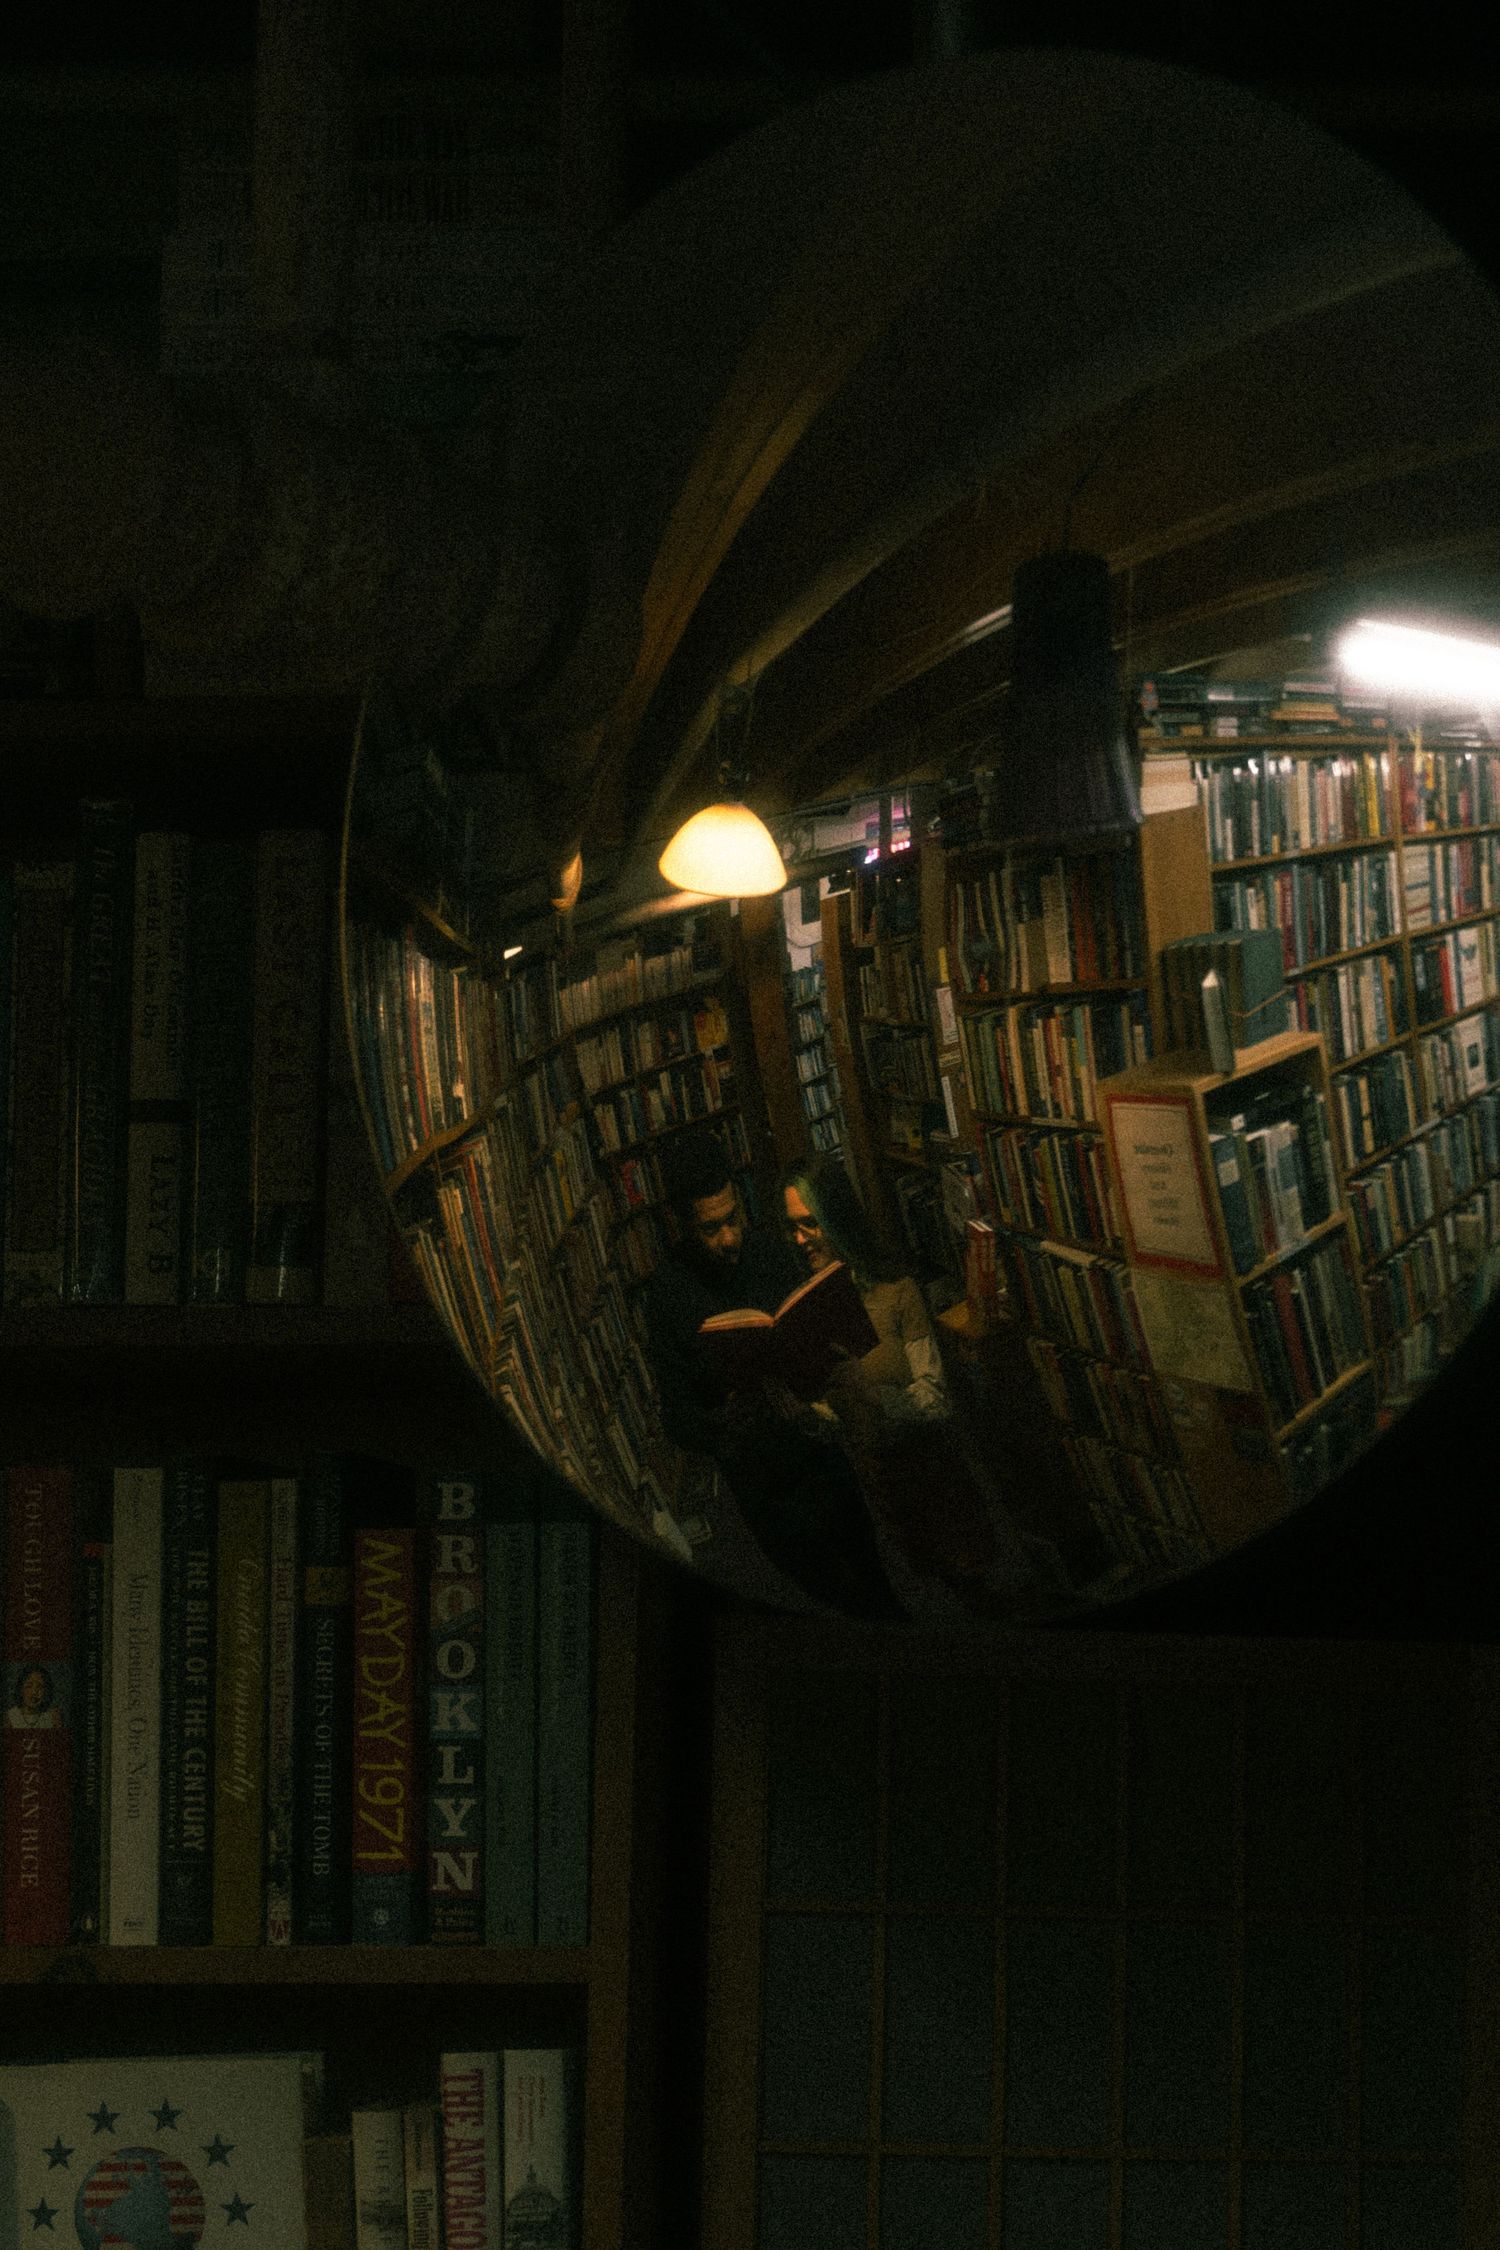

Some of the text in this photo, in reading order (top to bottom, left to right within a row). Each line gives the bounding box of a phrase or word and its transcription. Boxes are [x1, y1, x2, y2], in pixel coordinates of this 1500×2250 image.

[149, 1154, 177, 1275] LAZY B
[24, 1483, 45, 1651] TOUGH LOVE
[126, 1573, 149, 1618] Many
[128, 1717, 149, 1756] One
[183, 1549, 210, 1851] THE BILL OF THE CENTURY
[220, 1648, 260, 1802] Community
[311, 1617, 334, 1876] SECRETS OF THE TOMB
[356, 1538, 407, 1862] MAYDAY 1971
[434, 1481, 477, 1892] BROOKLYN
[20, 1738, 40, 1889] SUSAN RICE
[128, 1762, 148, 1820] Nation
[443, 2068, 485, 2127] THE
